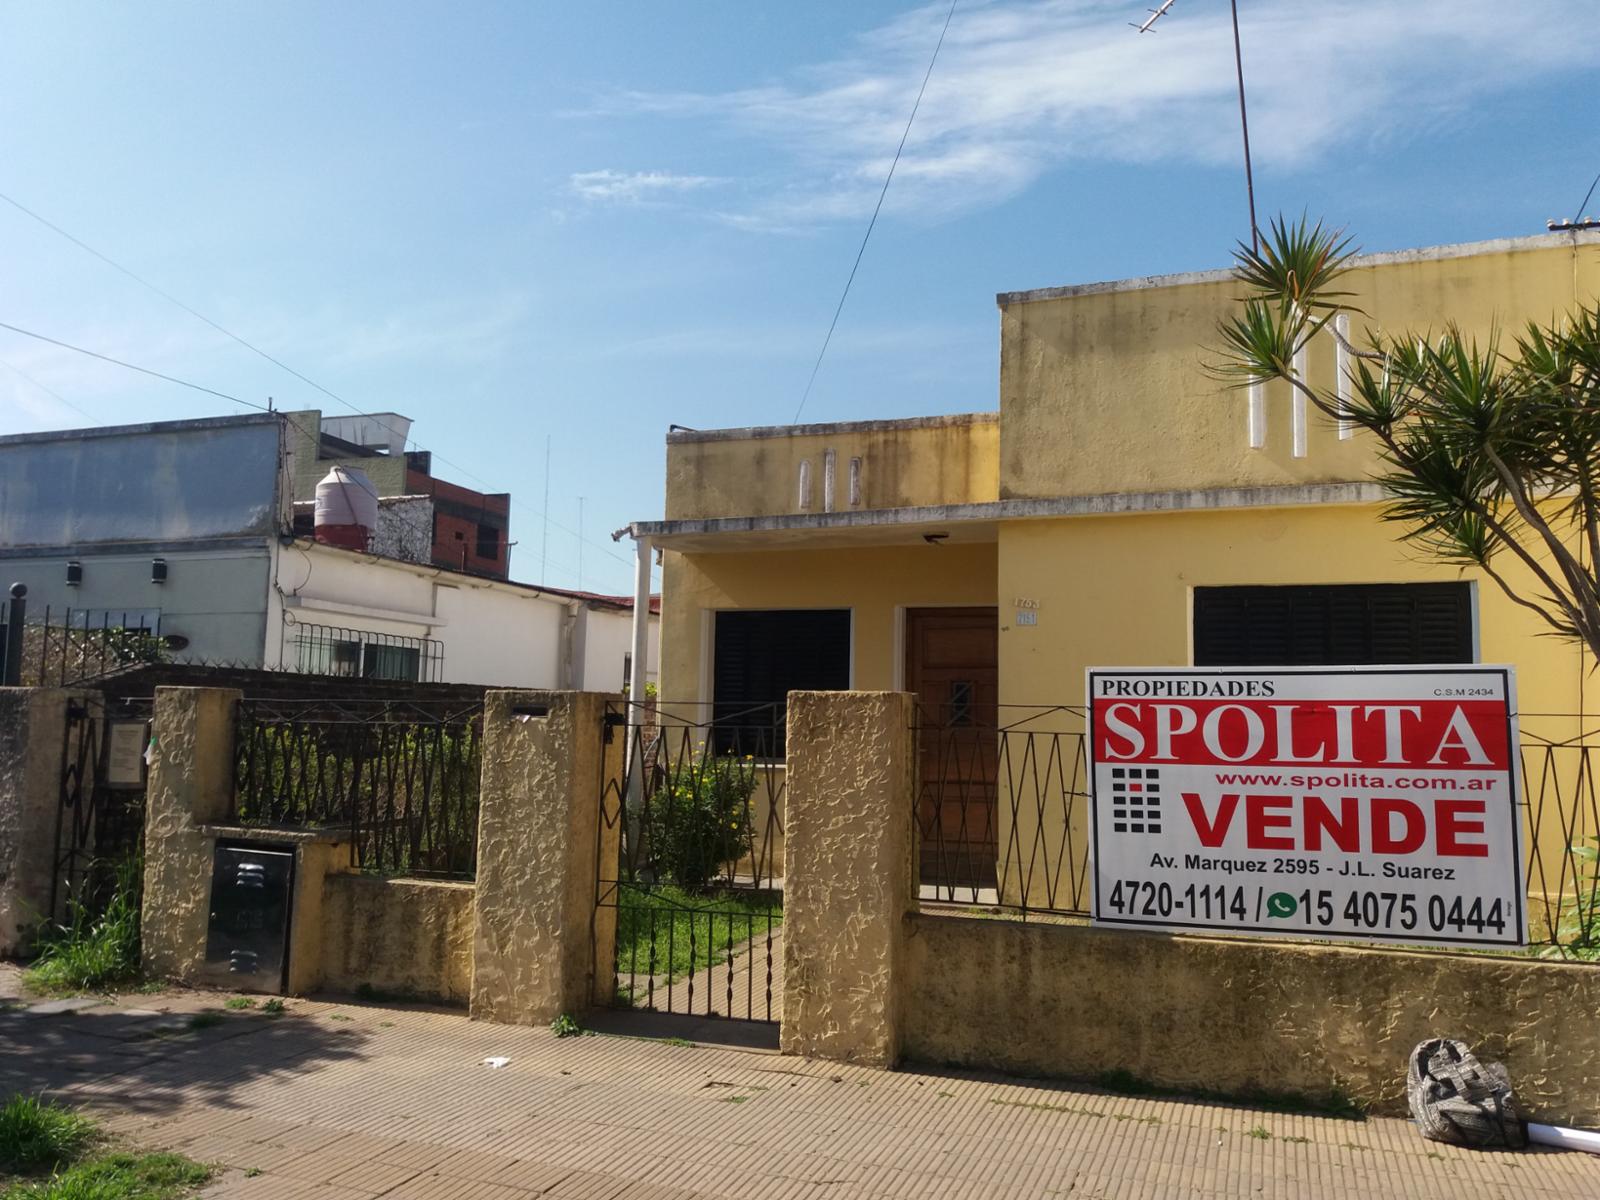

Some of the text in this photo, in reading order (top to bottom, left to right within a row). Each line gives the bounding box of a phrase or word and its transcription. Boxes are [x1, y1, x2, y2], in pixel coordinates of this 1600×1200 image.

[1100, 680, 1275, 697] PROPIEDADES
[1433, 688, 1494, 697] C.S.M 2434
[1104, 702, 1496, 765] SPOLITA
[1215, 773, 1497, 791] www.spolita.com.ar
[1181, 793, 1489, 857] VENDE
[1150, 853, 1178, 869] Av.
[1185, 854, 1267, 875] Marquez
[1273, 858, 1320, 875] 2595
[1339, 861, 1375, 877] J.L.
[1382, 862, 1456, 880] Suarez
[1109, 880, 1247, 921] 4720-1114
[1299, 889, 1334, 926] 15
[1343, 891, 1418, 930] 4075
[1428, 895, 1506, 935] 0444
